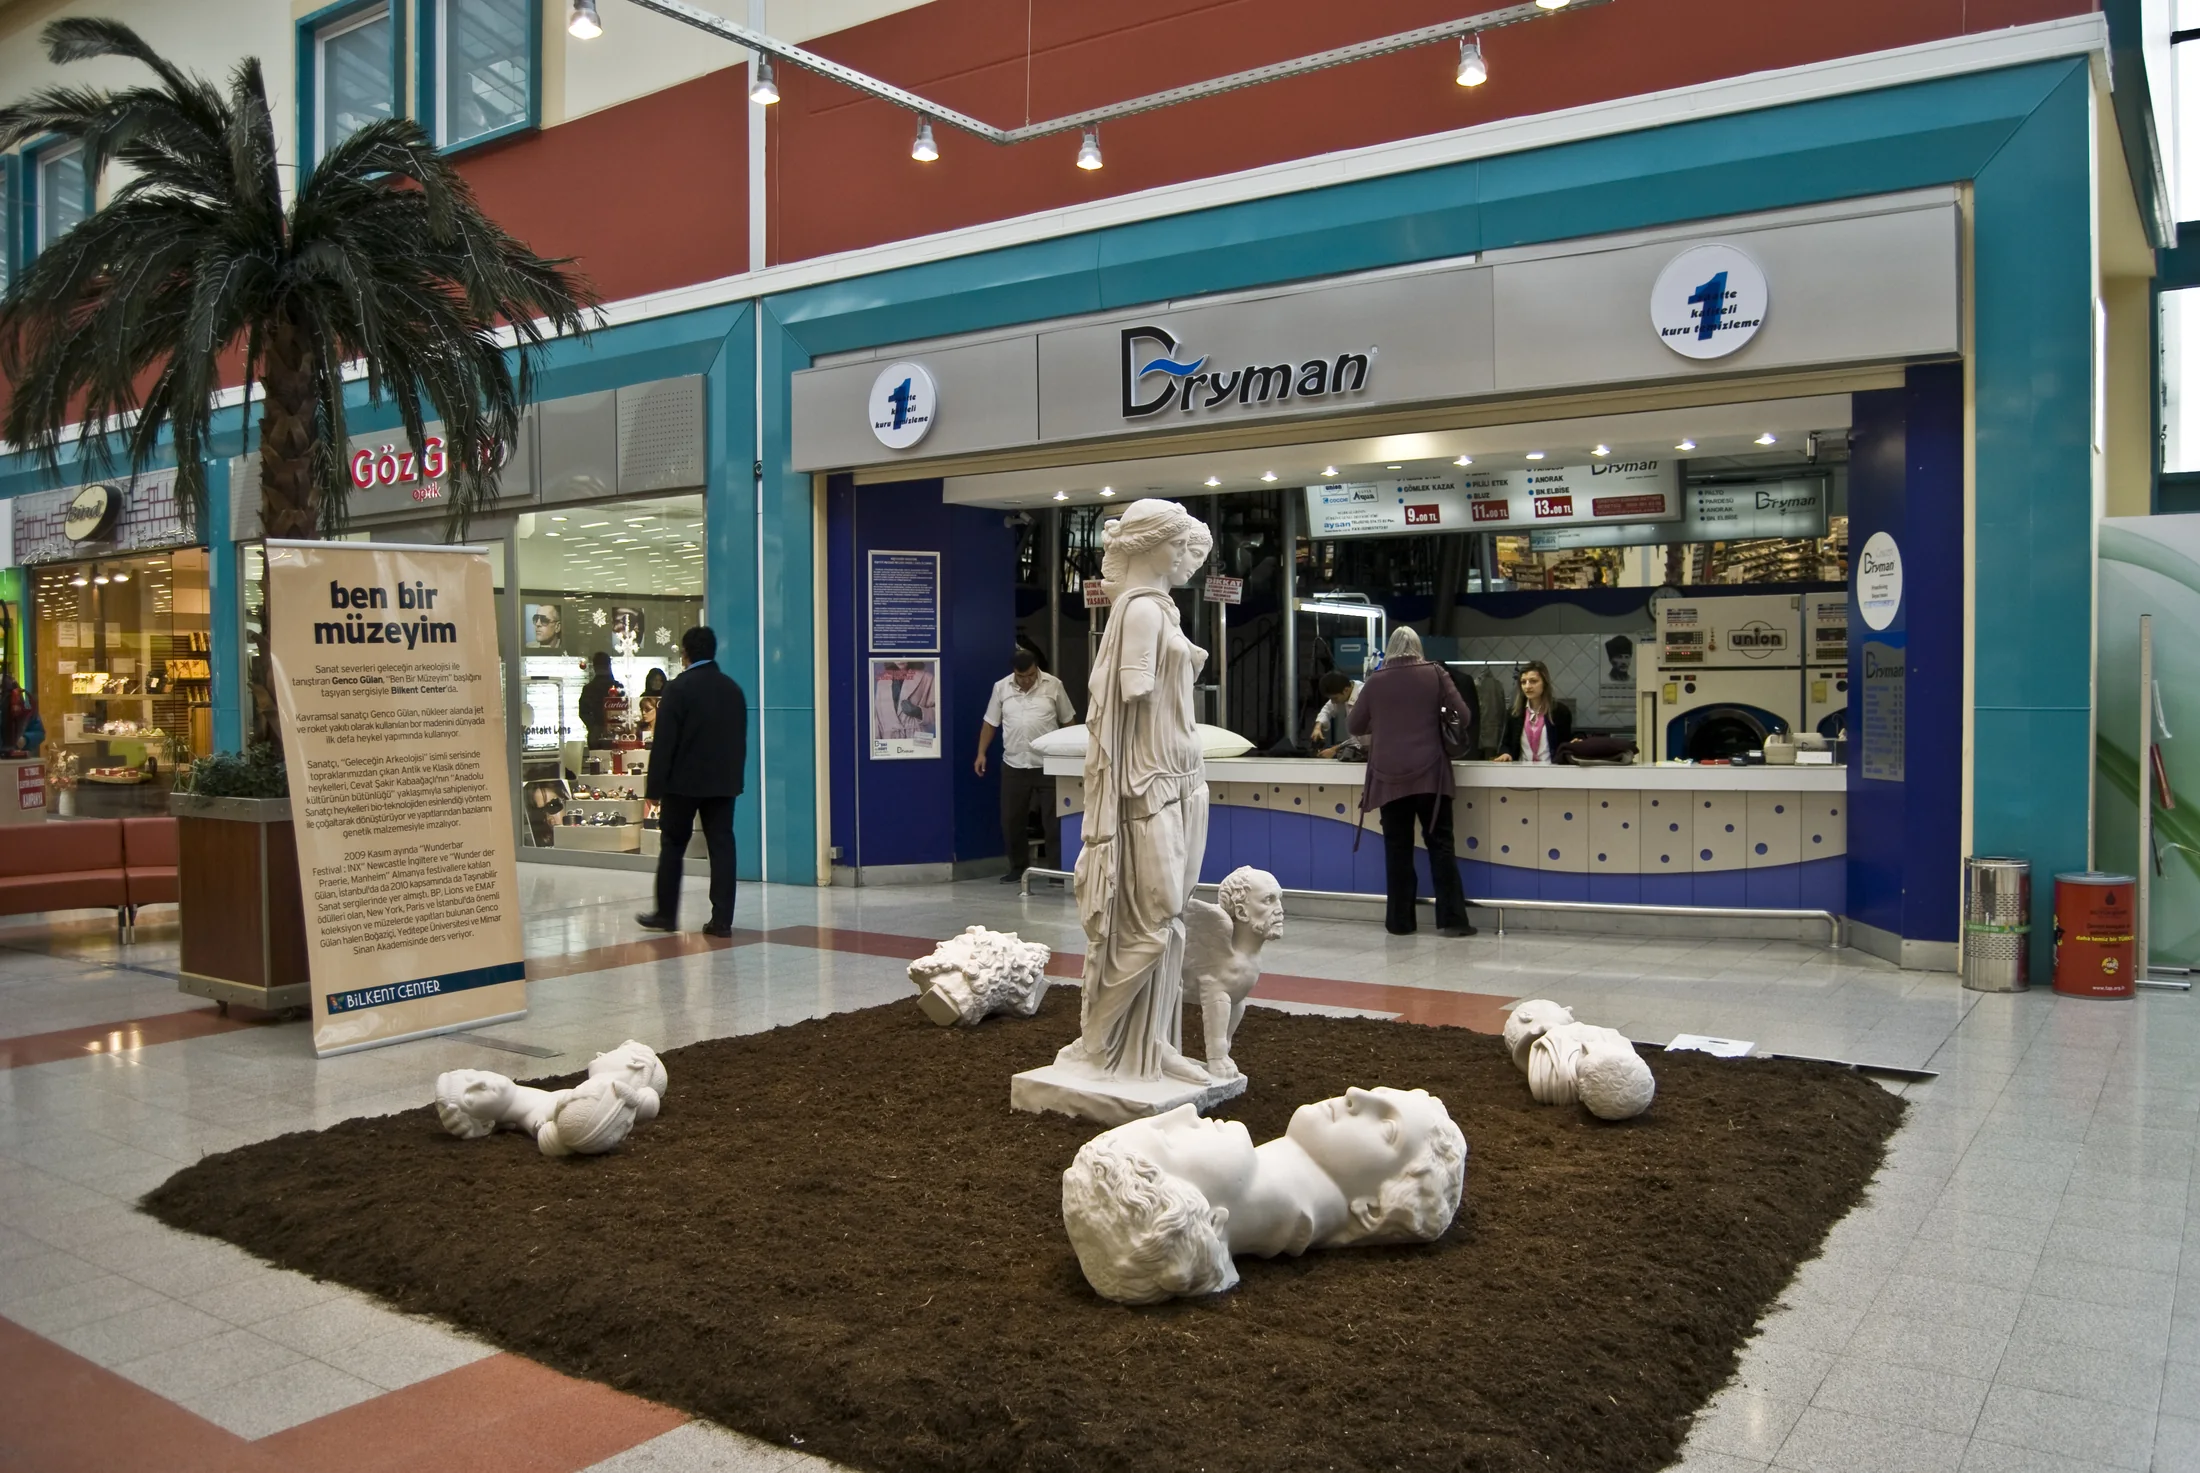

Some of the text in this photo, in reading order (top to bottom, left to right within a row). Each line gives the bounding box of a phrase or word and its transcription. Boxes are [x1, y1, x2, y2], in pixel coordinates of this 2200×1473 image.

[1688, 271, 1728, 341] 1
[1662, 320, 1759, 336] kuru temizleme
[1121, 326, 1369, 418] Dryman
[892, 406, 916, 414] keli
[352, 444, 417, 489] Göz
[412, 481, 441, 502] optik
[1404, 484, 1429, 492] GÖMLEK
[1408, 508, 1427, 522] 9.00
[1472, 504, 1508, 518] 11.00 TL
[1535, 500, 1572, 515] 13.00 TL
[1324, 521, 1350, 529] aysan
[1865, 552, 1894, 574] Dryman
[330, 580, 438, 609] ben bir
[314, 613, 457, 650] müzeyim
[1732, 627, 1782, 646] union
[316, 665, 339, 674] Sanat
[341, 664, 375, 673] severleri
[377, 663, 413, 675] geleceğin
[414, 663, 450, 674] arkeolojisi
[292, 677, 330, 687] tanıştıran
[360, 676, 385, 684] Gülan,
[453, 674, 481, 684] başlığını
[321, 686, 418, 698] taşıyan sergisiyle Bilkent
[296, 706, 484, 722] Kavramsal sanatçı Genco Gülan, nükleer alanda jet
[329, 723, 349, 733] yakıtı
[351, 722, 374, 731] olarak
[375, 721, 409, 730] kullanılan
[423, 718, 454, 728] madenini
[455, 717, 485, 727] dünyada
[337, 735, 355, 743] defa
[356, 734, 382, 745] heykel
[385, 731, 422, 744] yapımında
[308, 760, 340, 769] Sanatçı,
[449, 751, 480, 759] serisinde
[310, 762, 480, 781] topraklarımızdan çıkan Antik Klasik dönem
[306, 784, 488, 805] kültürünün yaklaşımıyla sahipleniyor.
[308, 781, 373, 794] heykelleri, Cevat
[306, 795, 491, 817] Sanatçı heykelleri bio-teknolojiden yöntem
[315, 817, 355, 829] çoğaltarak
[356, 813, 406, 825] dönüştürüyor
[417, 808, 461, 820] yapıtlarından
[343, 822, 425, 839] genetik malzemesiyle
[344, 846, 418, 861] 2009 Kasım ayında
[312, 865, 342, 876] Festival
[367, 858, 407, 870] Newcastle
[392, 861, 491, 879] Almanya festivallere katılan
[315, 870, 497, 900] Gülan, 2010 kapsamında Taşınabilir
[318, 881, 496, 912] Sanat sergilerinde almıştı. Lions EMAF
[318, 892, 500, 924] ödülleri olan, York, Paris önemli
[321, 904, 499, 936] koleksiyon müzelerde yapıtları bulunan Genco
[320, 914, 501, 948] Gülan halen Yeditepe Üniversitesi Mimar
[353, 930, 475, 954] Sinan Akademisinde ders veriyor.
[397, 980, 441, 999] CENTER
